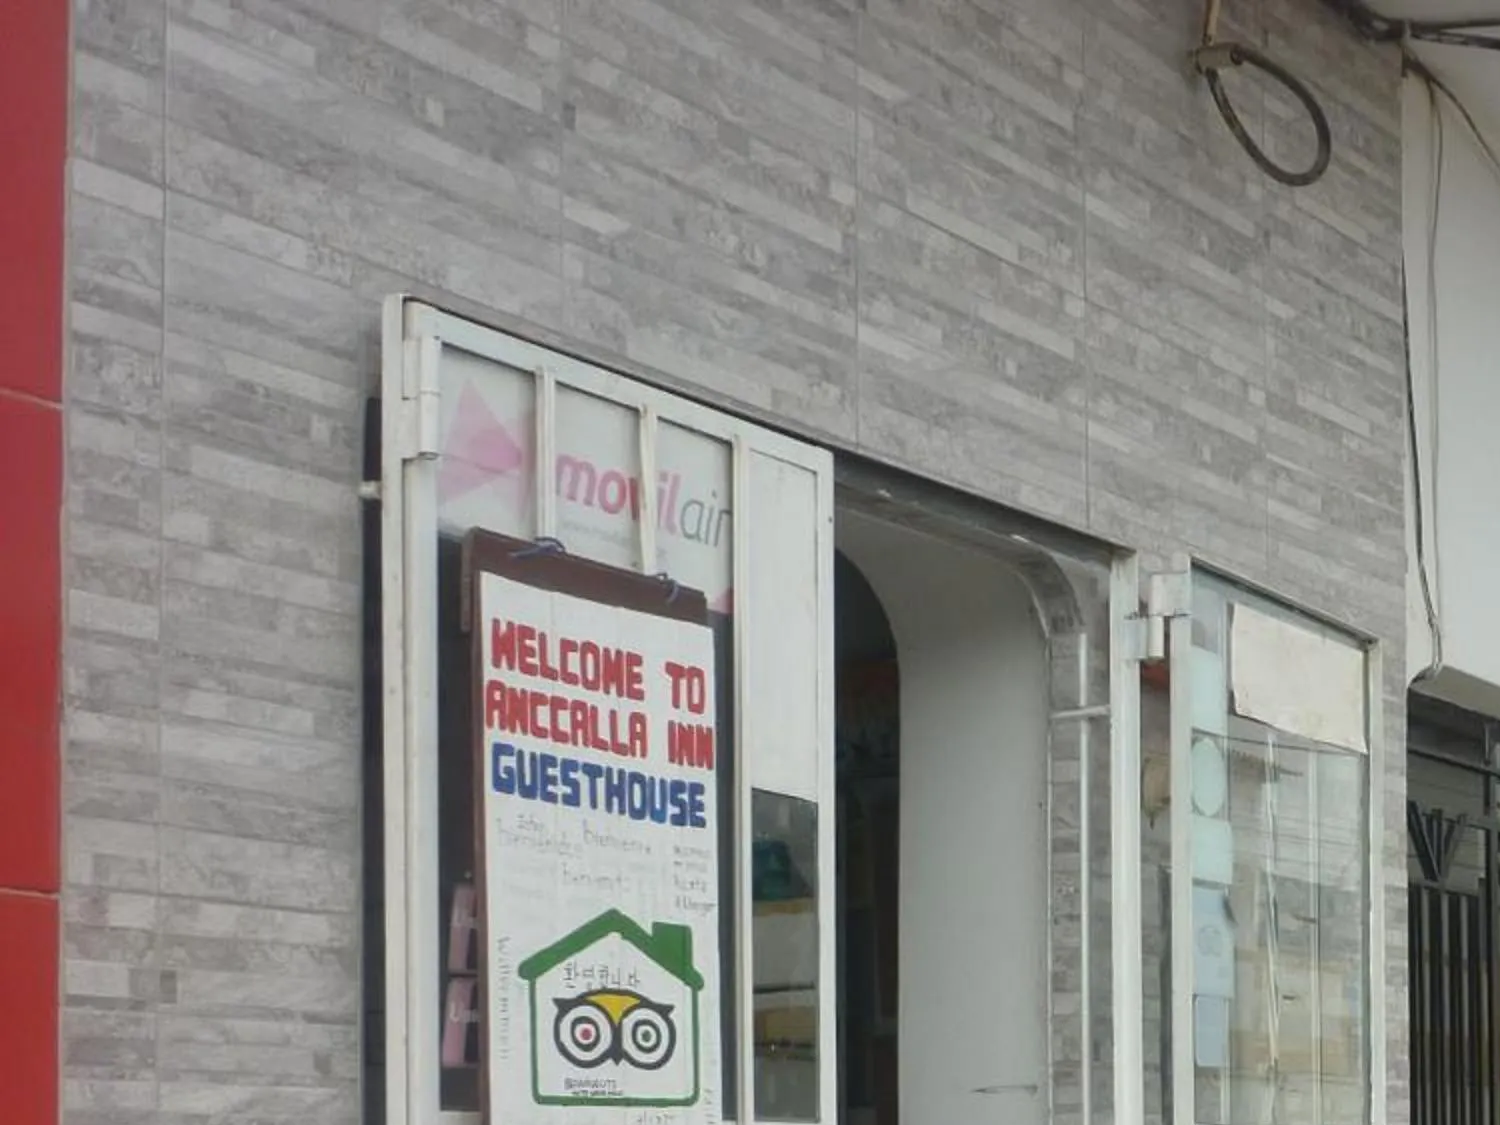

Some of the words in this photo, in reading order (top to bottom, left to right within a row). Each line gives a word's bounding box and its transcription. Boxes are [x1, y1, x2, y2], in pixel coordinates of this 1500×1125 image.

[491, 617, 645, 701] WELCOME
[665, 660, 706, 715] TO
[485, 679, 648, 759] ANCCALLA
[668, 719, 714, 770] INN
[491, 742, 707, 829] GUESTHOUSE
